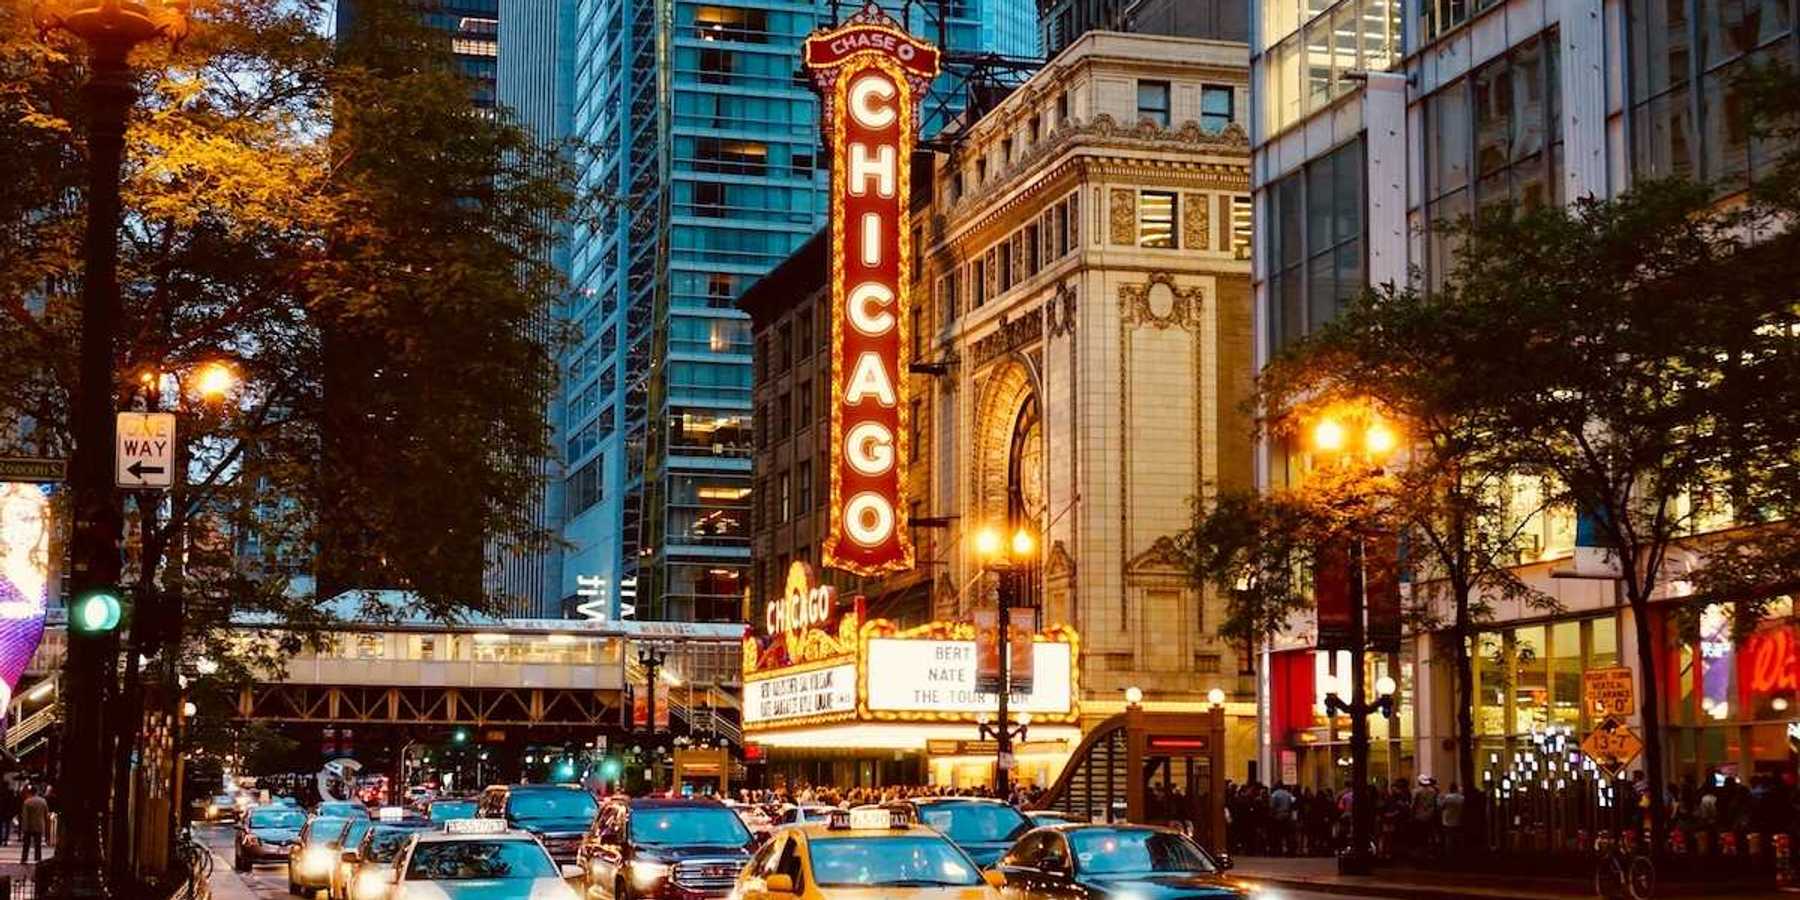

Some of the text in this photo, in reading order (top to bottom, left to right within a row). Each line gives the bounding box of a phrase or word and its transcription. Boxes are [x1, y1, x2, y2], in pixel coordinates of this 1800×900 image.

[831, 33, 895, 55] CHASE
[843, 76, 897, 547] CHICAGO
[127, 419, 166, 437] ONE
[124, 440, 167, 457] WAY
[766, 584, 829, 636] CHICAGO
[936, 646, 970, 660] BERT
[928, 668, 965, 682] NATE
[914, 689, 1029, 705] THE TOUR TUR
[833, 813, 850, 828] TAX
[890, 813, 908, 827] TAXI
